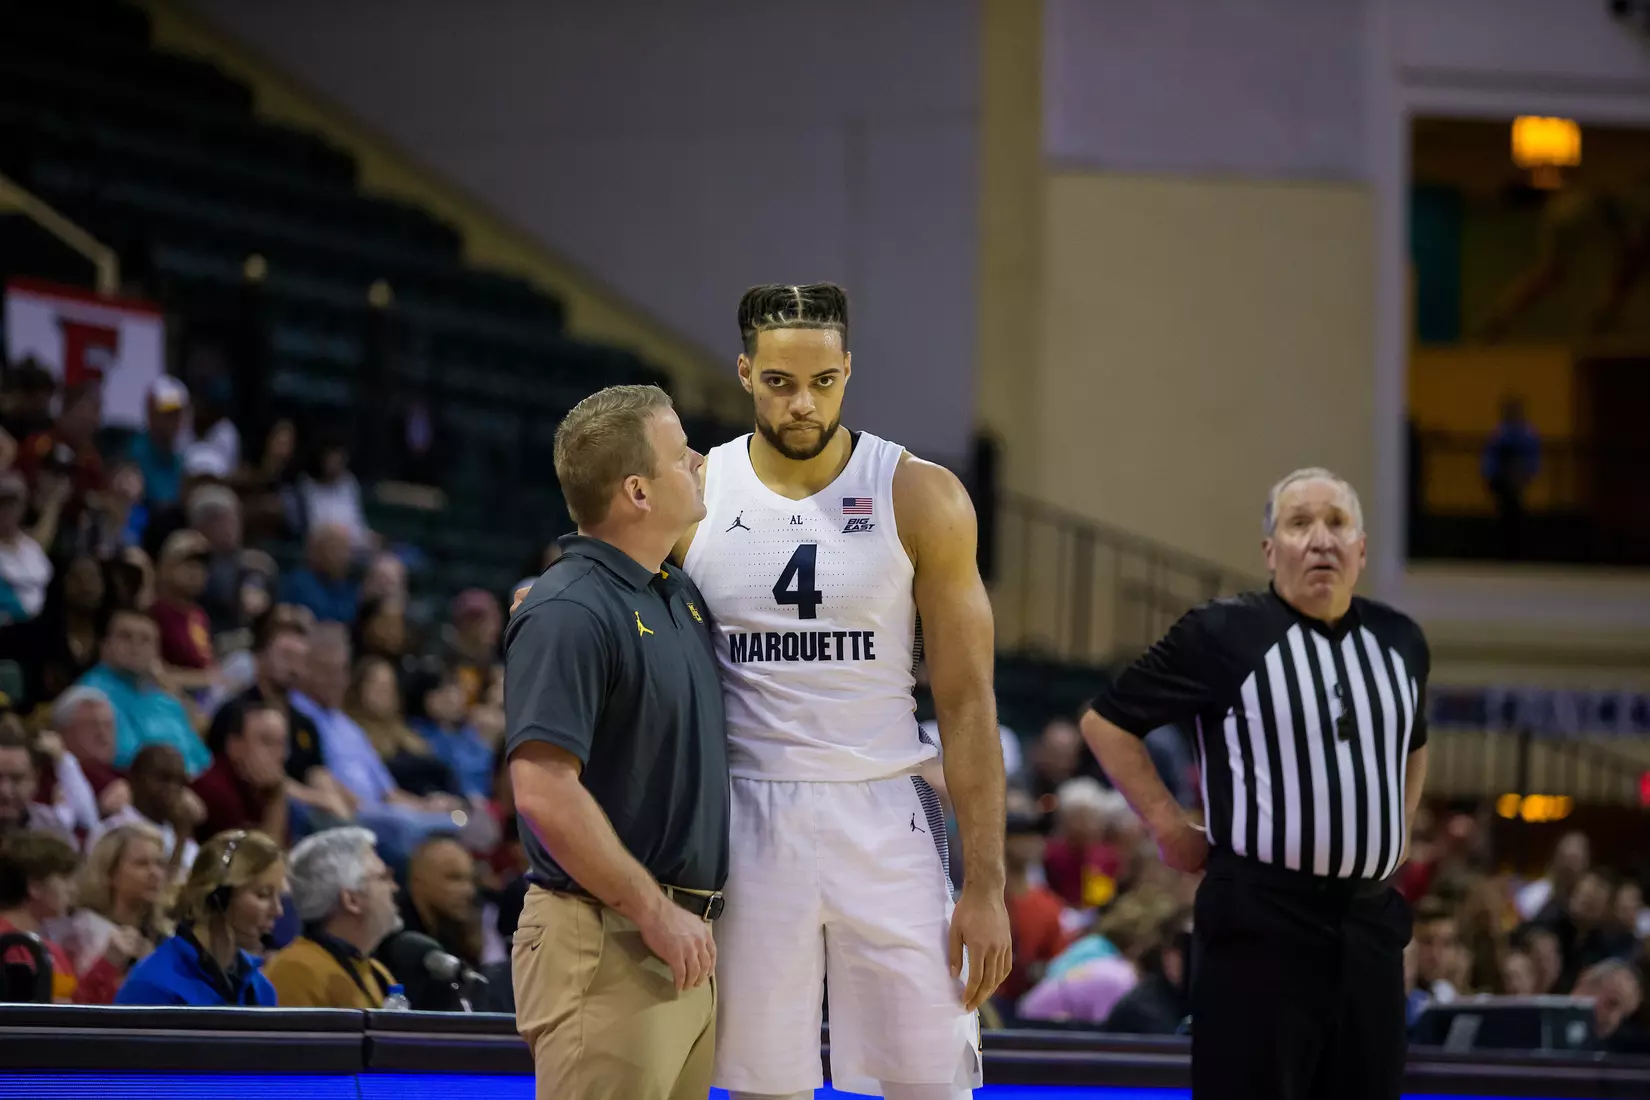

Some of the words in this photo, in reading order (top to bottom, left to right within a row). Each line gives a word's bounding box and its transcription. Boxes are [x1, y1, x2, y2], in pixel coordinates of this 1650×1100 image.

[790, 514, 803, 525] AL
[848, 517, 870, 525] BIG
[771, 543, 823, 620] 4
[729, 630, 876, 664] MARQUETTE
